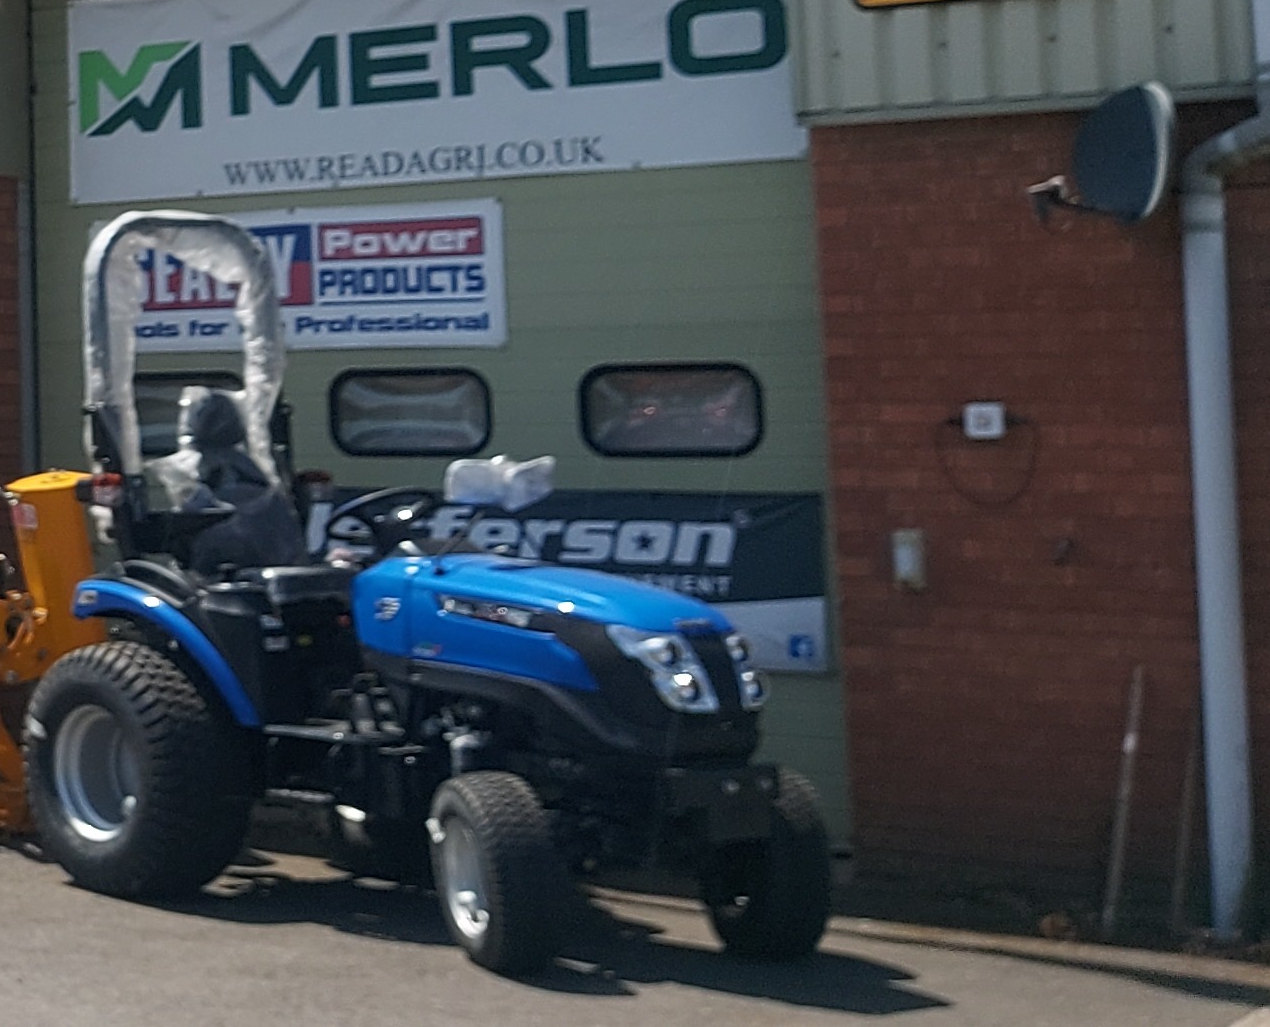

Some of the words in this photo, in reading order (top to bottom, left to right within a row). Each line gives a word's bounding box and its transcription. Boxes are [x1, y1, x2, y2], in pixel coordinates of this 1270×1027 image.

[323, 226, 480, 257] Power
[318, 263, 486, 297] PRODUCTS
[189, 319, 229, 337] for
[295, 310, 491, 335] Professional
